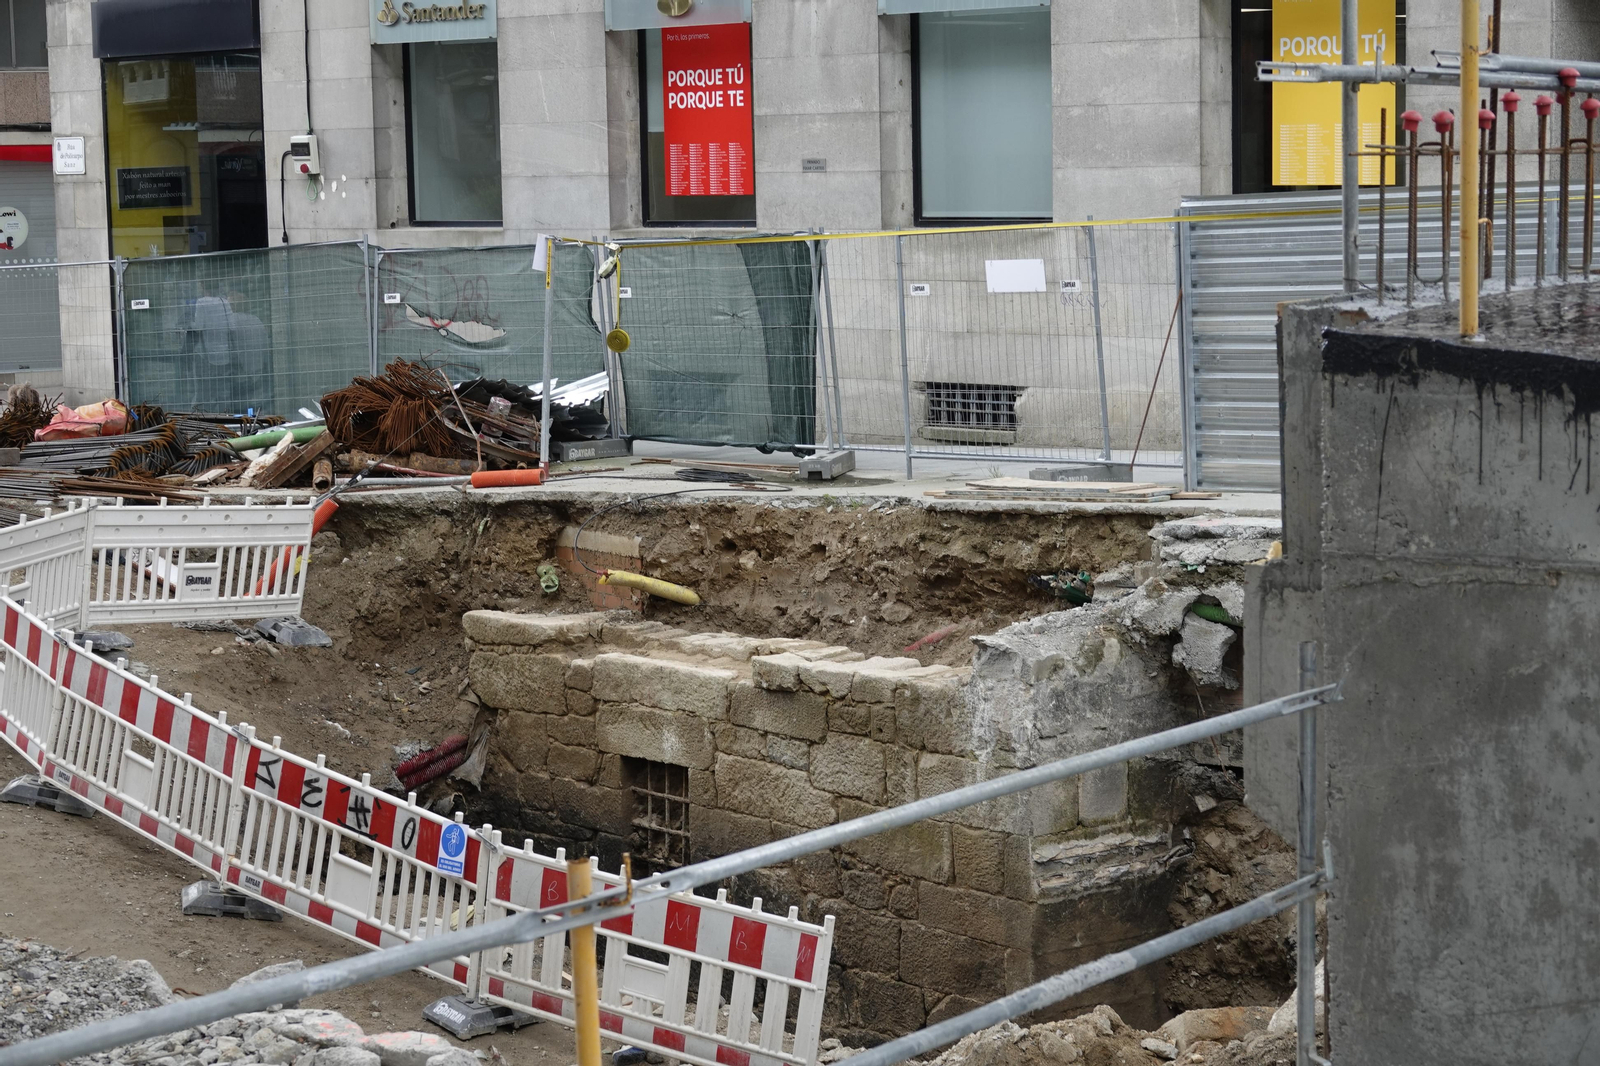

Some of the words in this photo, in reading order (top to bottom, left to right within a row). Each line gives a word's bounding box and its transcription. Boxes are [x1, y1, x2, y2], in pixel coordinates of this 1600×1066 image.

[402, 0, 487, 24] Santander
[1280, 36, 1342, 58] PORQU
[1361, 29, 1386, 54] TÚ
[668, 69, 723, 88] PORQUE
[726, 63, 744, 85] TÚ
[668, 91, 724, 110] PORQUE
[727, 90, 744, 107] TE
[143, 170, 164, 178] natural
[138, 182, 153, 191] feito
[124, 194, 135, 202] por
